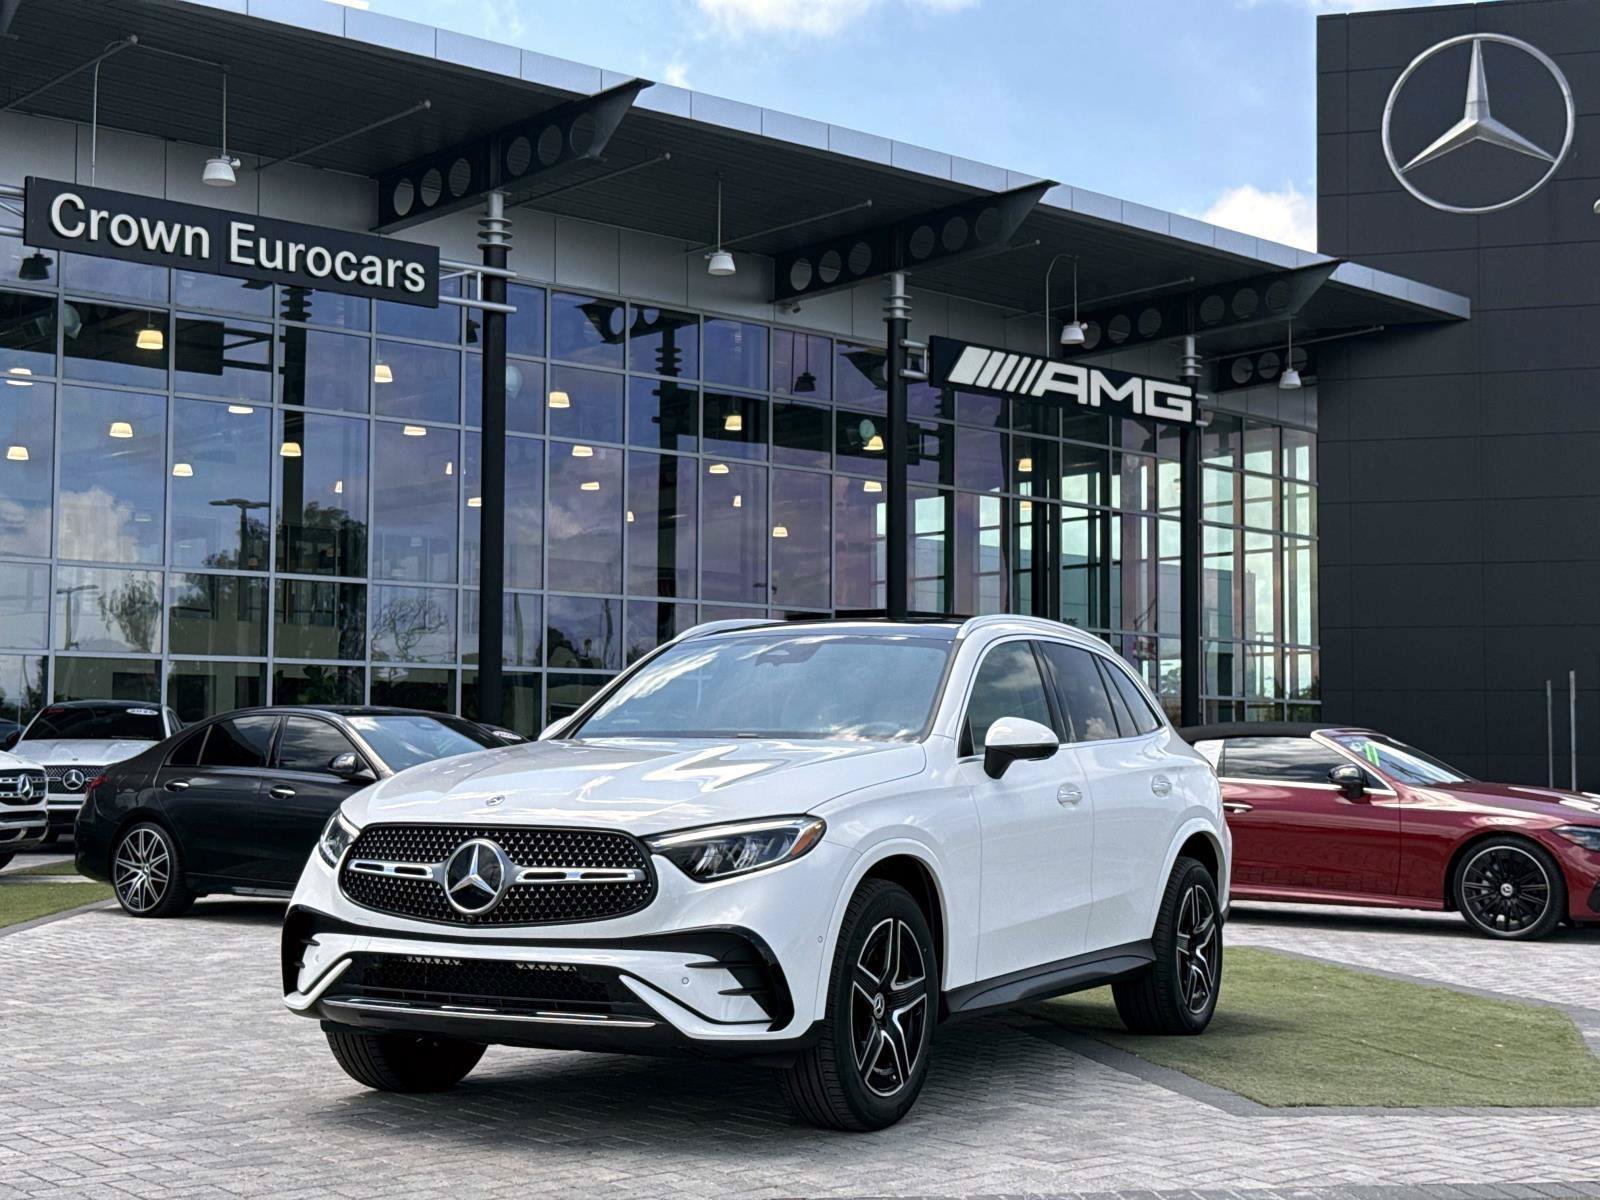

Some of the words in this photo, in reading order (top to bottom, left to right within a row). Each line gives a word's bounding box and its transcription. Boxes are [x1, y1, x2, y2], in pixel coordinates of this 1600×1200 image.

[50, 193, 210, 259] Crown
[229, 221, 426, 293] Eurocars
[1030, 361, 1193, 423] AMG
